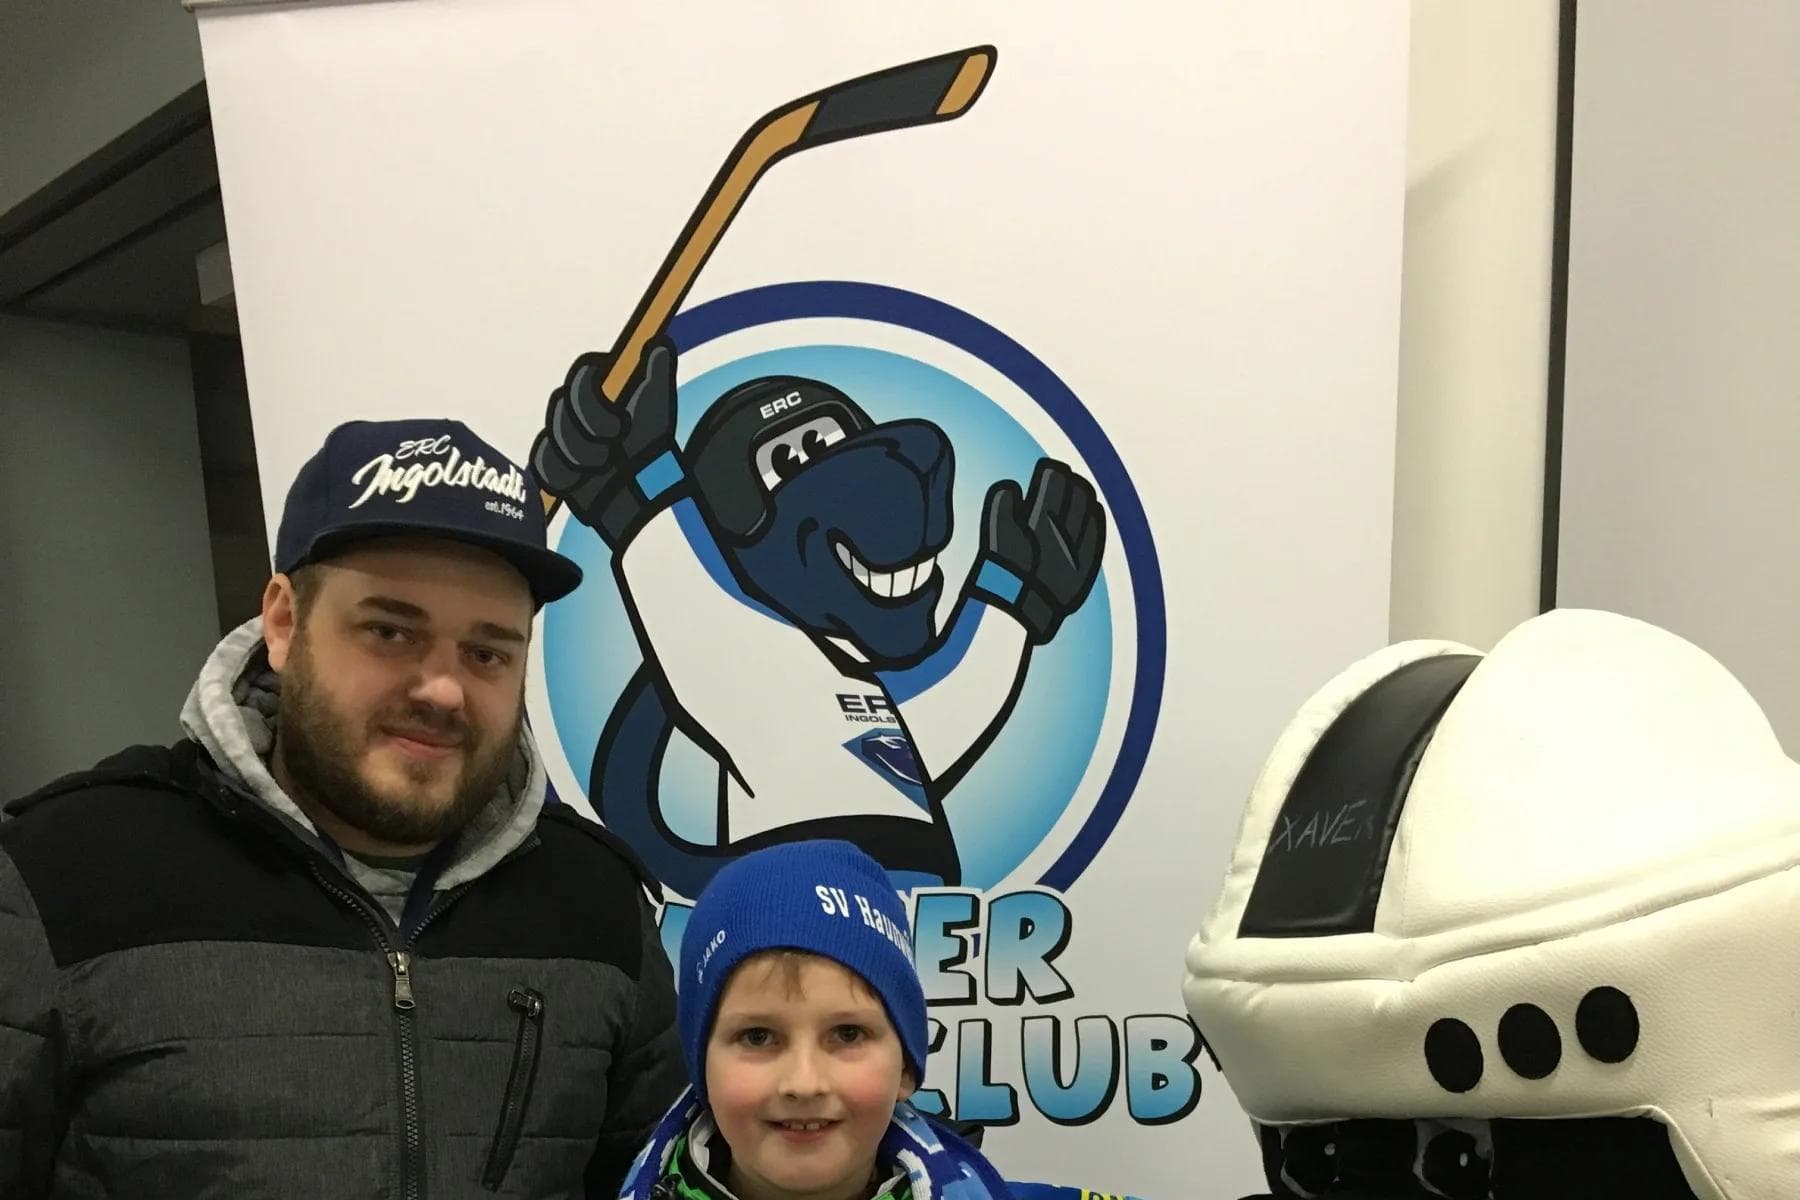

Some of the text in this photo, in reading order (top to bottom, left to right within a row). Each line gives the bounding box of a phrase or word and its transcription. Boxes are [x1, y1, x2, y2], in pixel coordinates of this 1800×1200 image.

[760, 391, 802, 420] ERC
[395, 434, 451, 459] ERC
[348, 446, 526, 508] Ingolstadt
[836, 693, 896, 714] ER
[845, 714, 896, 724] INGOLS
[815, 885, 850, 918] SV
